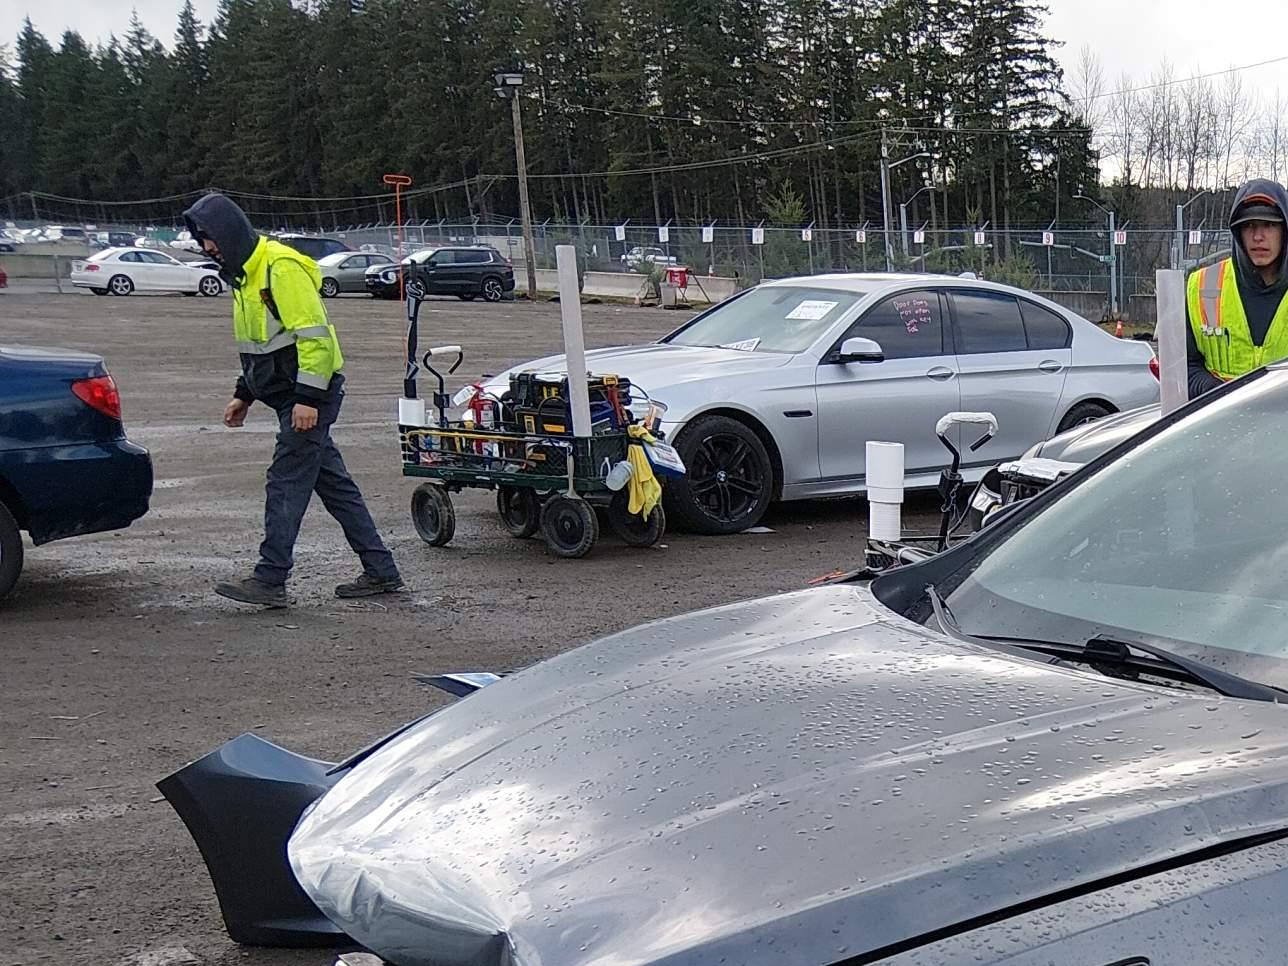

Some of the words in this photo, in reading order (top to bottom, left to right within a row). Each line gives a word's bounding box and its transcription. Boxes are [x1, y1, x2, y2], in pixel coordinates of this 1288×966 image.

[1045, 233, 1051, 243] 9
[1116, 232, 1125, 244] 10
[1192, 232, 1199, 242] 11
